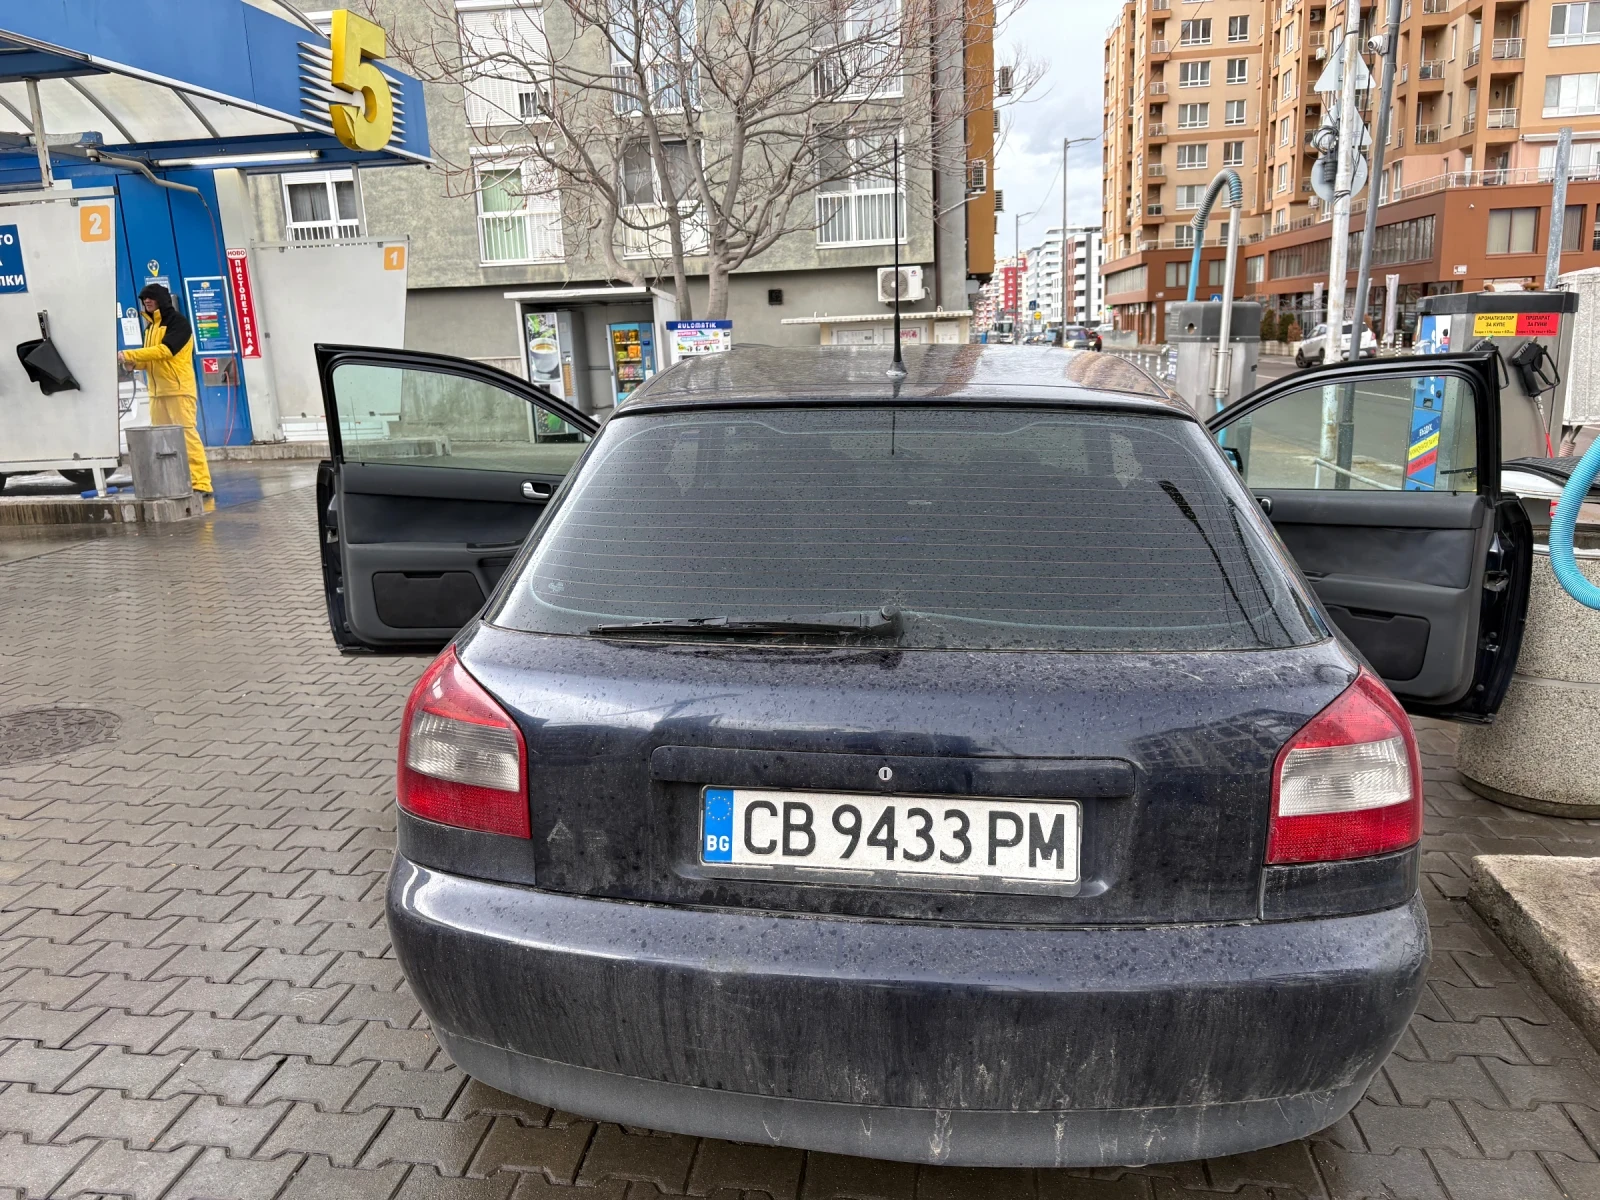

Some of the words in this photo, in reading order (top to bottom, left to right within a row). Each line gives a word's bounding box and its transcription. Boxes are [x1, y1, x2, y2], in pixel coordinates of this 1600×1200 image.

[331, 9, 393, 151] 5
[89, 212, 103, 235] 2
[390, 251, 398, 266] 1
[234, 259, 248, 314] ПИСТОЛЕТ
[243, 317, 253, 345] ПЯНА
[706, 835, 730, 852] BG
[743, 800, 817, 857] CB
[831, 803, 973, 864] 9433
[987, 810, 1066, 870] PM
